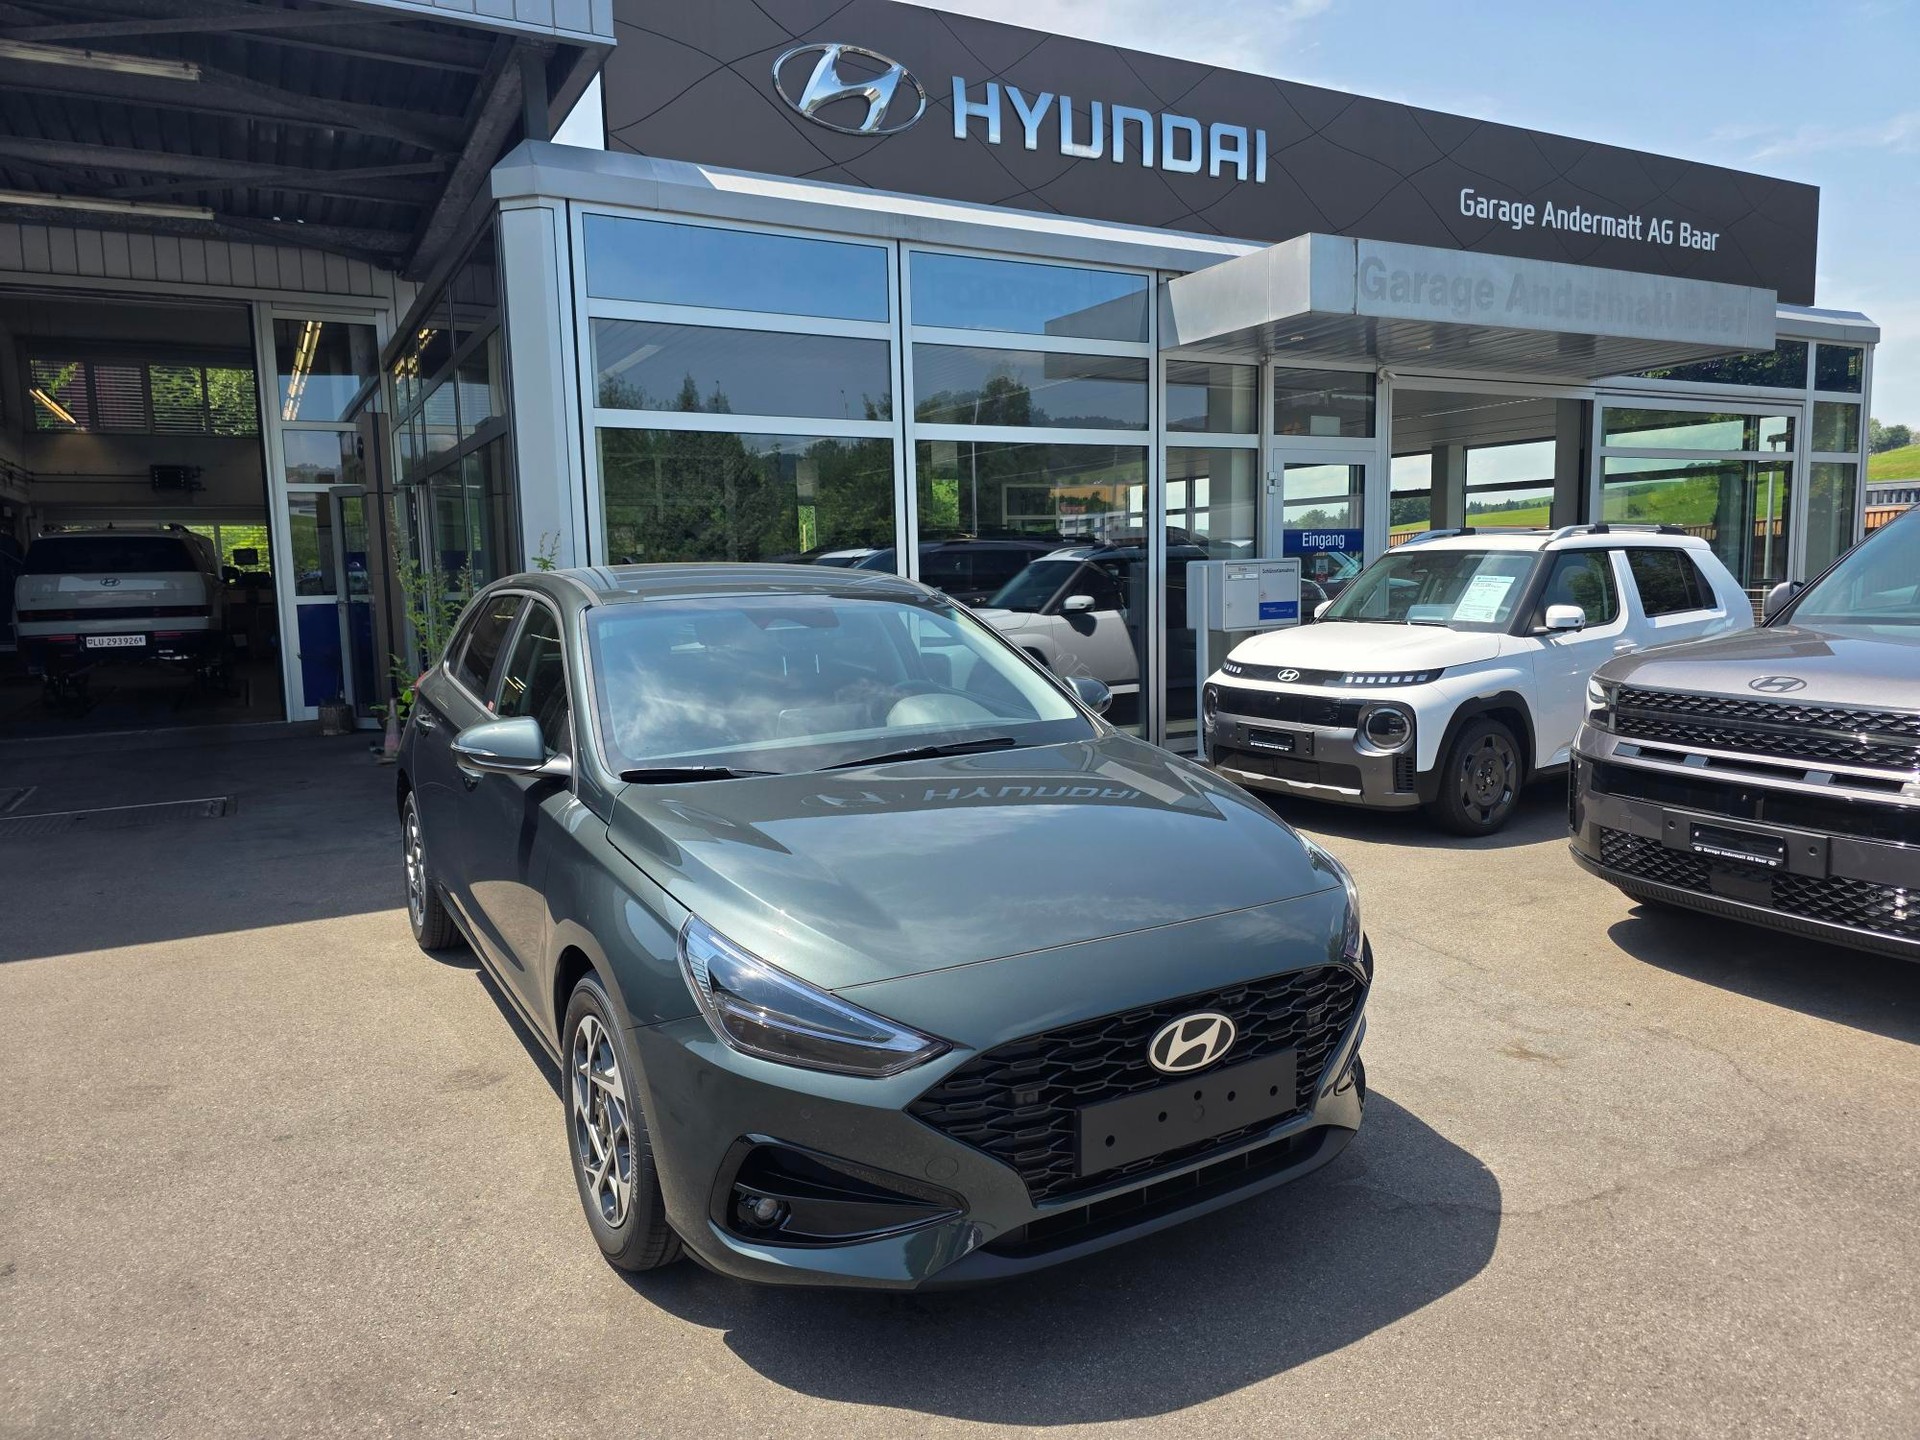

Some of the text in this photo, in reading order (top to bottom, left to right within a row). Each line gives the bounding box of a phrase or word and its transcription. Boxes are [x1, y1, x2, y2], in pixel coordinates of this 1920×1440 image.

[951, 75, 1266, 183] HYUNDAI
[1459, 188, 1720, 252] Garage Andermatt AG Baar
[1360, 256, 1495, 318] Garage
[1302, 532, 1345, 549] Eingang
